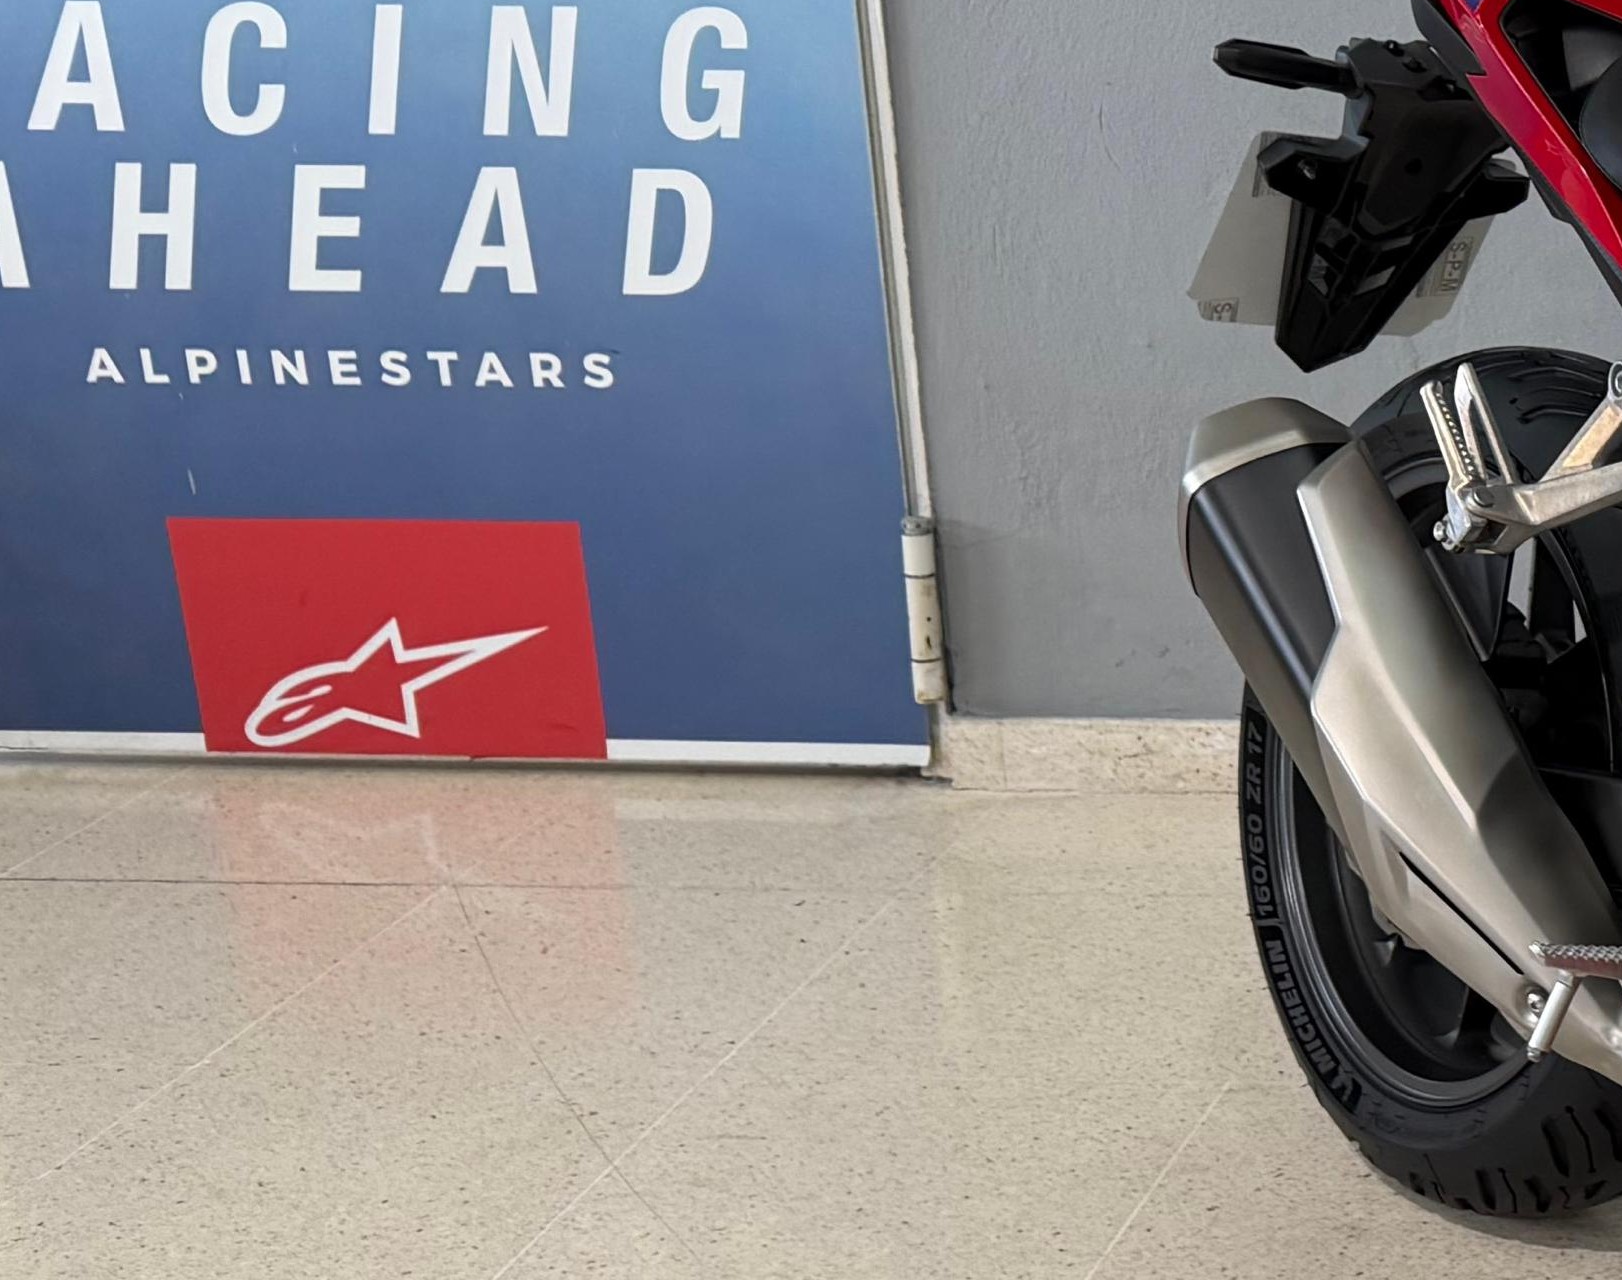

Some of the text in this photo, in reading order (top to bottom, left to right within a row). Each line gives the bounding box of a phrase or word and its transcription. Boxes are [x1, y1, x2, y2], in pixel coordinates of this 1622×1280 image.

[86, 346, 616, 389] ALPINESTARS
[1246, 720, 1274, 916] 160/60 ZR 17
[1265, 939, 1339, 1074] MICHELIN
